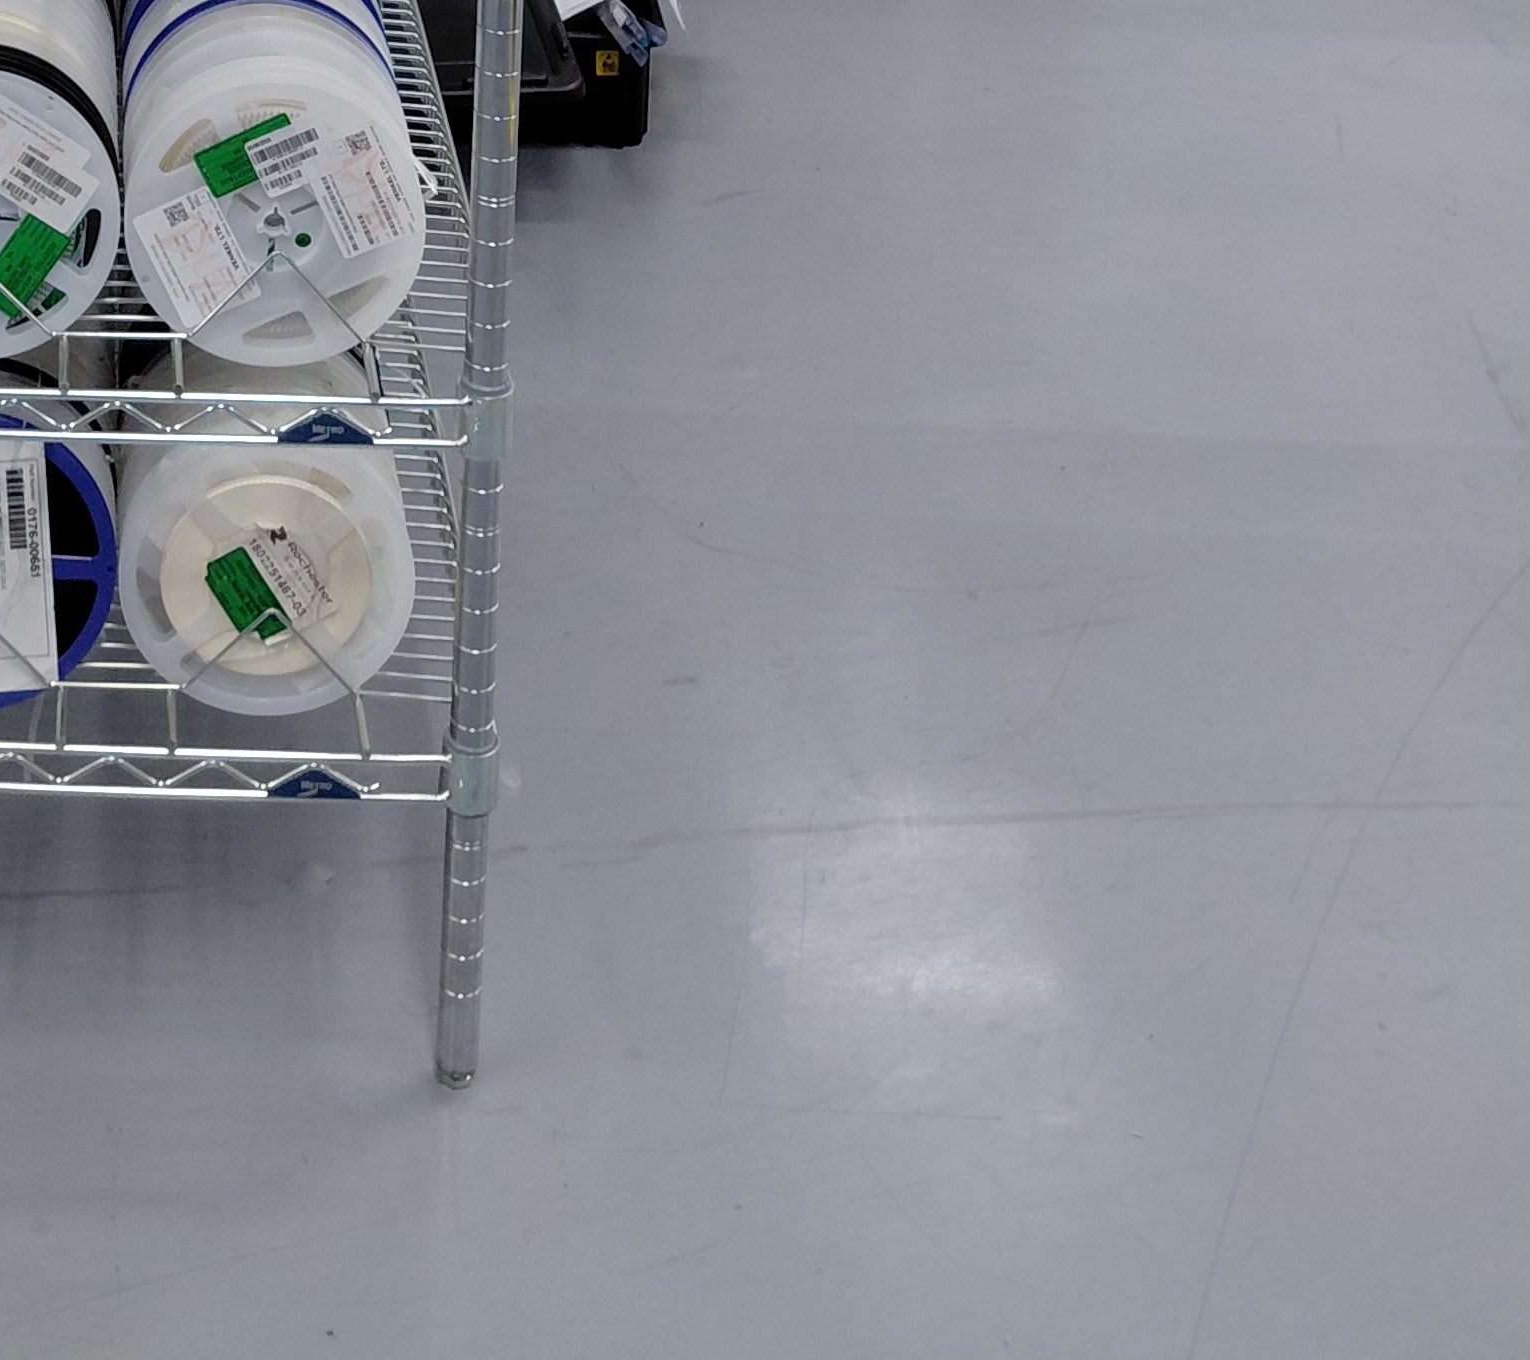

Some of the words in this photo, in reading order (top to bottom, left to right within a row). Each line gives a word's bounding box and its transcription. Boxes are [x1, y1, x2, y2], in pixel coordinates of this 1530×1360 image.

[221, 240, 240, 271] VENKEL
[26, 507, 41, 577] 0176-00651
[286, 539, 334, 605] Rochester
